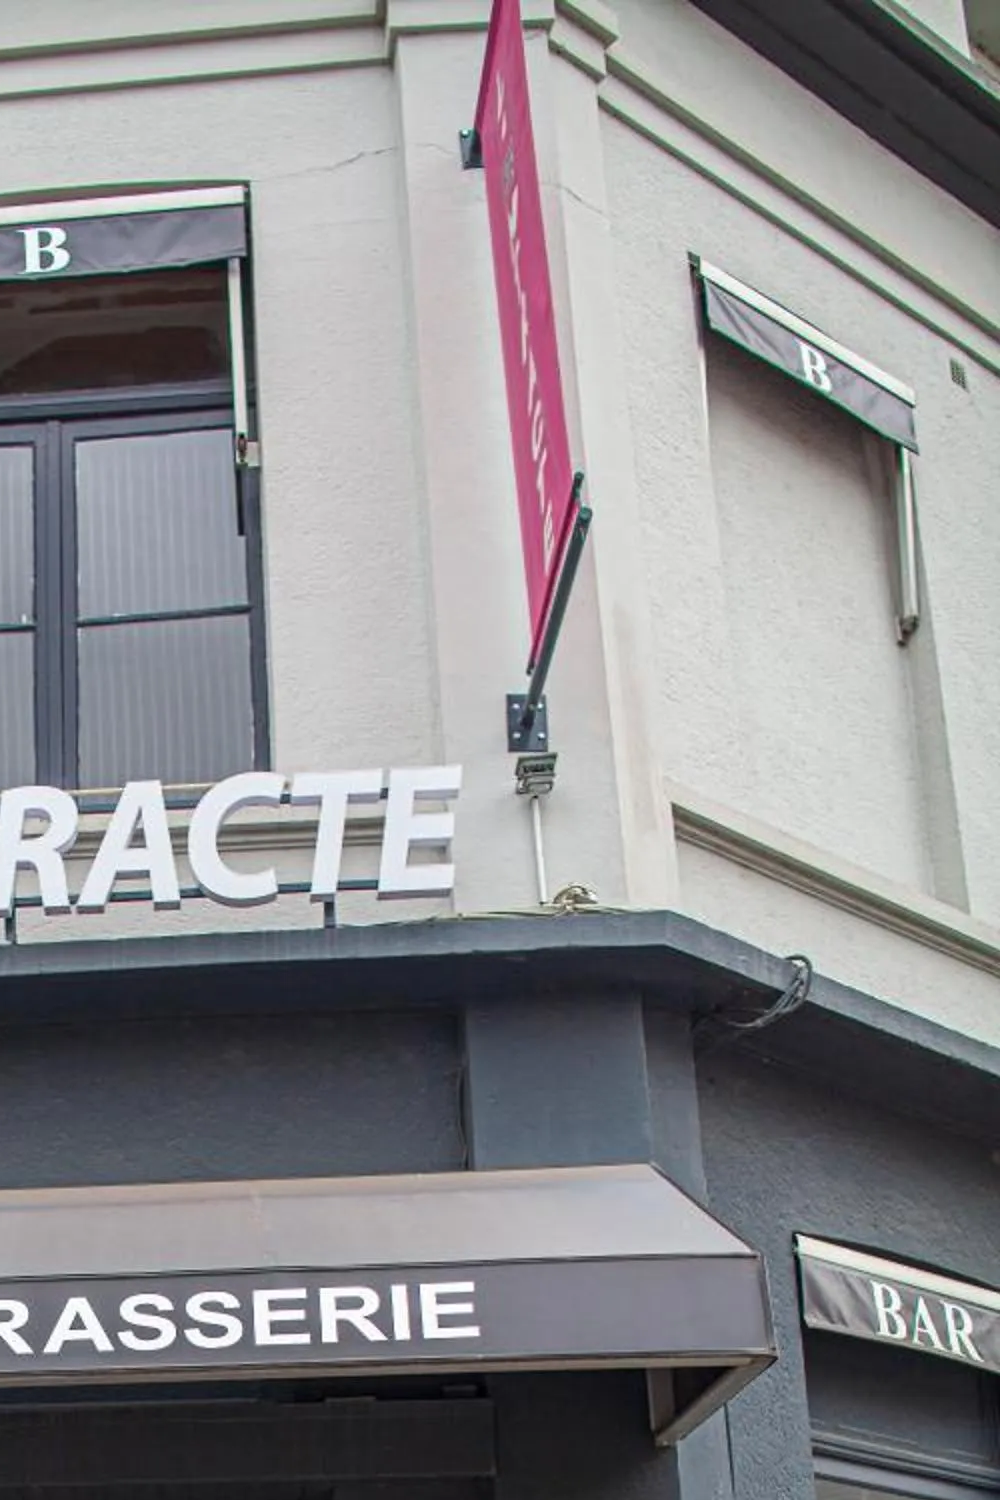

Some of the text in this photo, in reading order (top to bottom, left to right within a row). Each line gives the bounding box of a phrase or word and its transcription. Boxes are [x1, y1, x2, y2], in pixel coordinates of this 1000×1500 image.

[15, 227, 71, 275] B
[793, 336, 832, 391] B
[869, 1280, 985, 1362] BAR
